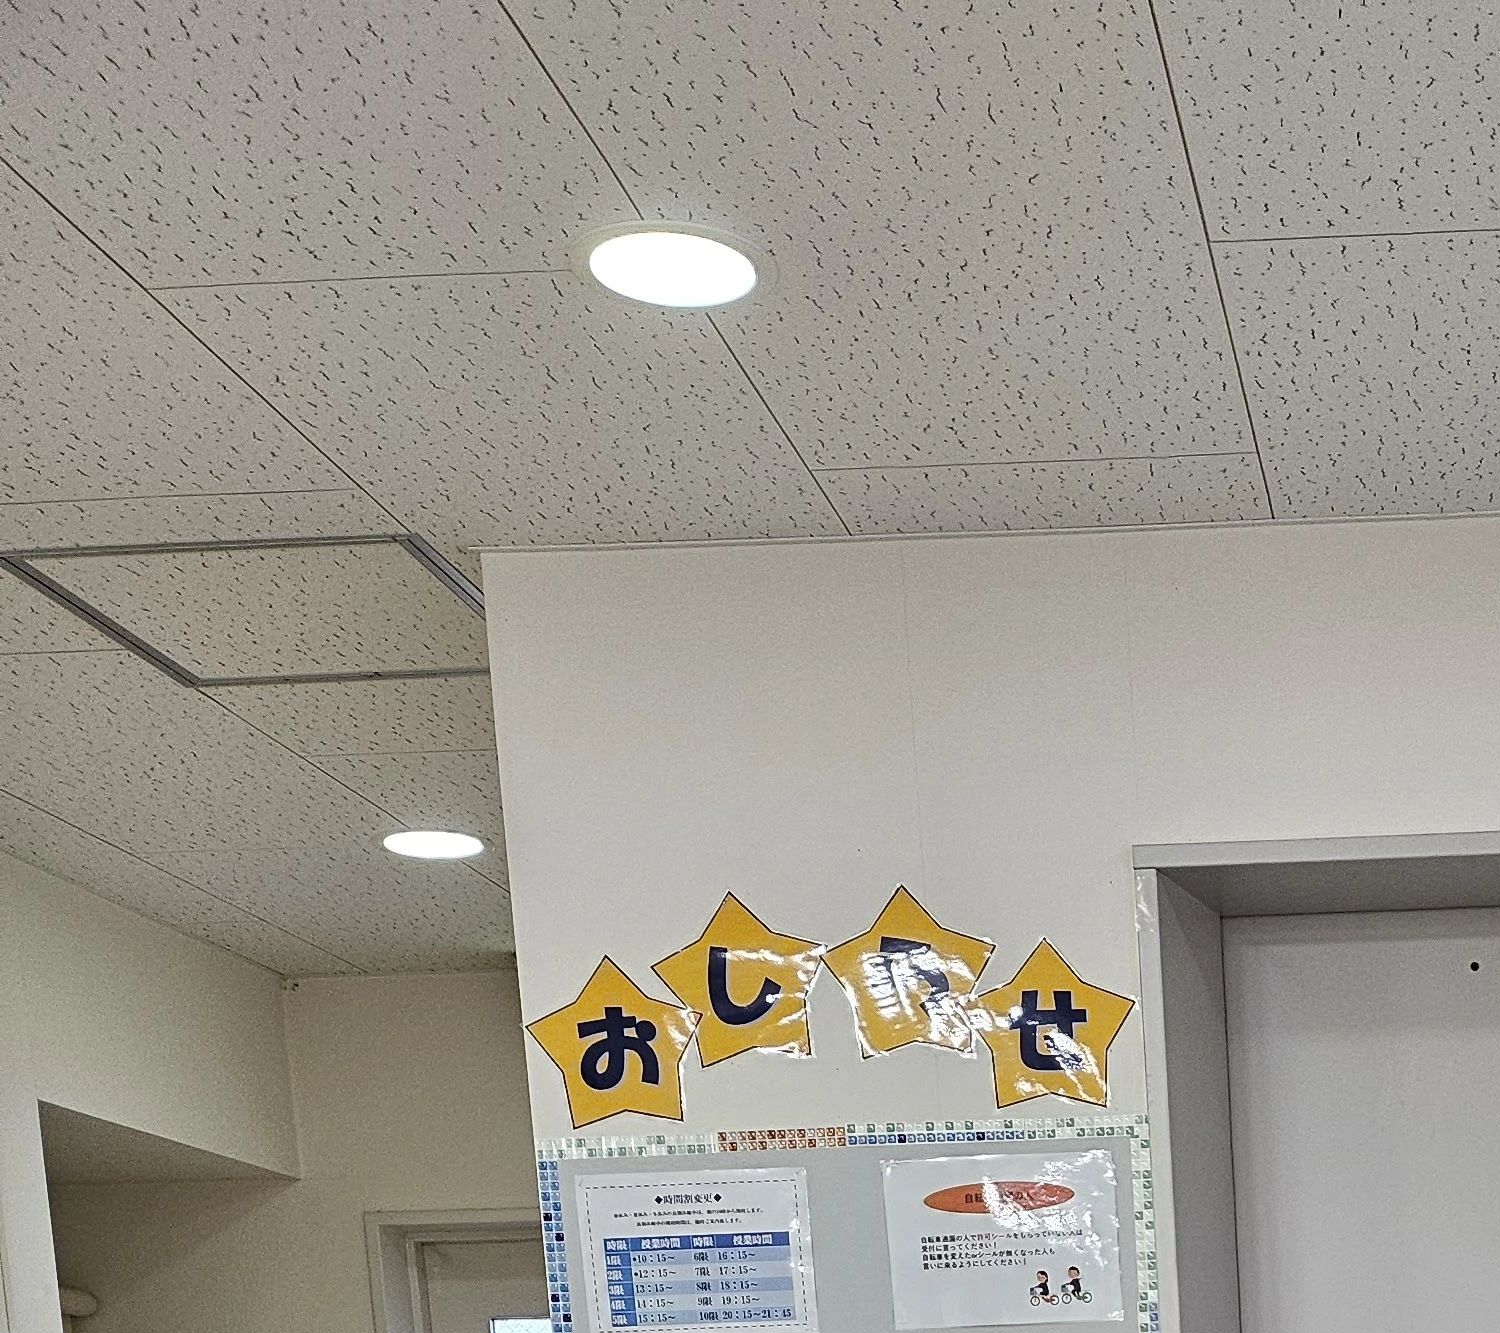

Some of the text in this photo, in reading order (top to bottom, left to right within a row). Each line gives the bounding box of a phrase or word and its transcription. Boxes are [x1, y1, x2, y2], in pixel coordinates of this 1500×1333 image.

[663, 1193, 712, 1204] 時間割変更
[607, 1234, 772, 1250] 時限 授業時間 時限 授業時間
